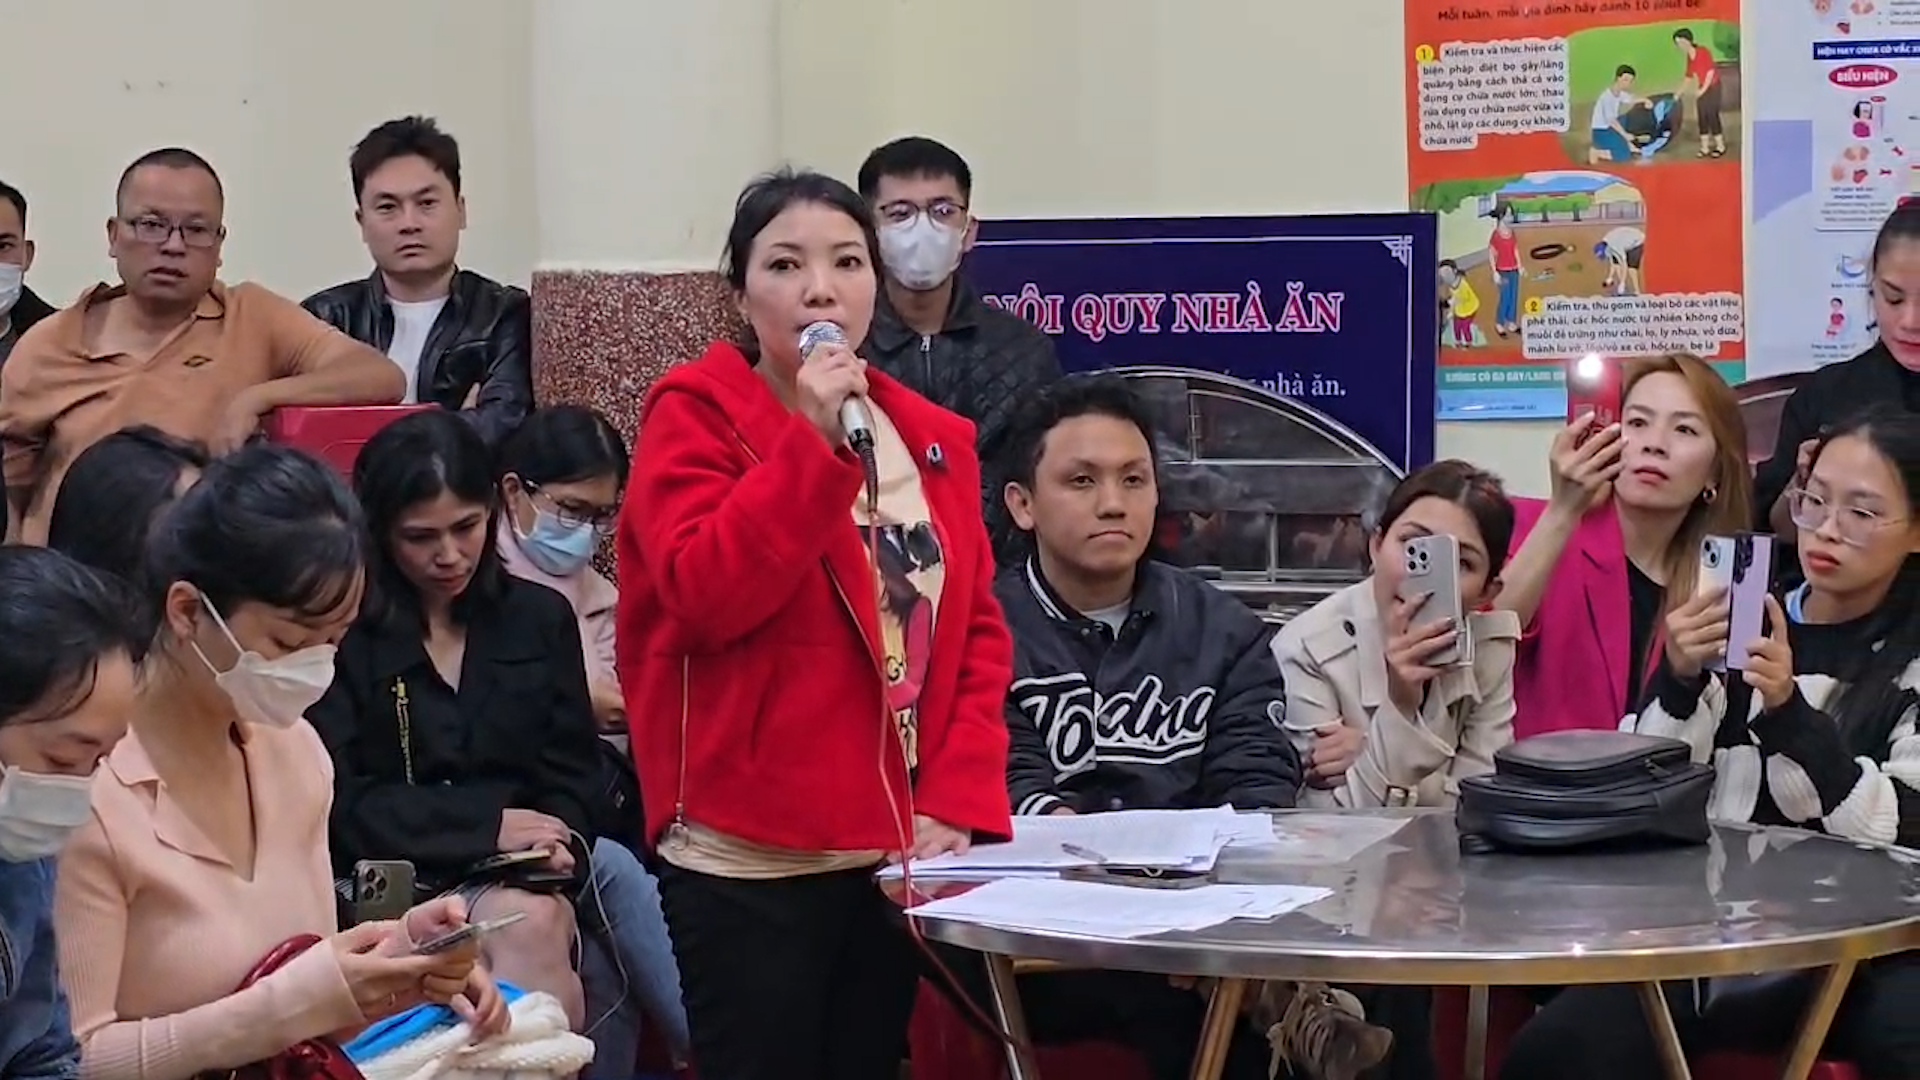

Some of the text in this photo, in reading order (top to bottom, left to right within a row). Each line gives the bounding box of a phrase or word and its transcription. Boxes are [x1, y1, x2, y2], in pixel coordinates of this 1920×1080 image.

[1471, 47, 1484, 56] tra
[1487, 46, 1498, 55] và
[1449, 64, 1474, 77] pháp
[1485, 75, 1507, 85] cách
[1546, 74, 1564, 82] vào
[1542, 88, 1564, 97] thau
[1553, 102, 1564, 111] và
[1071, 291, 1166, 343] QUY
[1171, 279, 1272, 335] NHÀ
[1276, 280, 1345, 335] ĂN
[1592, 300, 1609, 310] thu
[1611, 302, 1633, 313] gom
[1635, 300, 1647, 309] và
[1720, 311, 1739, 321] cho
[1311, 374, 1346, 396] ăn.
